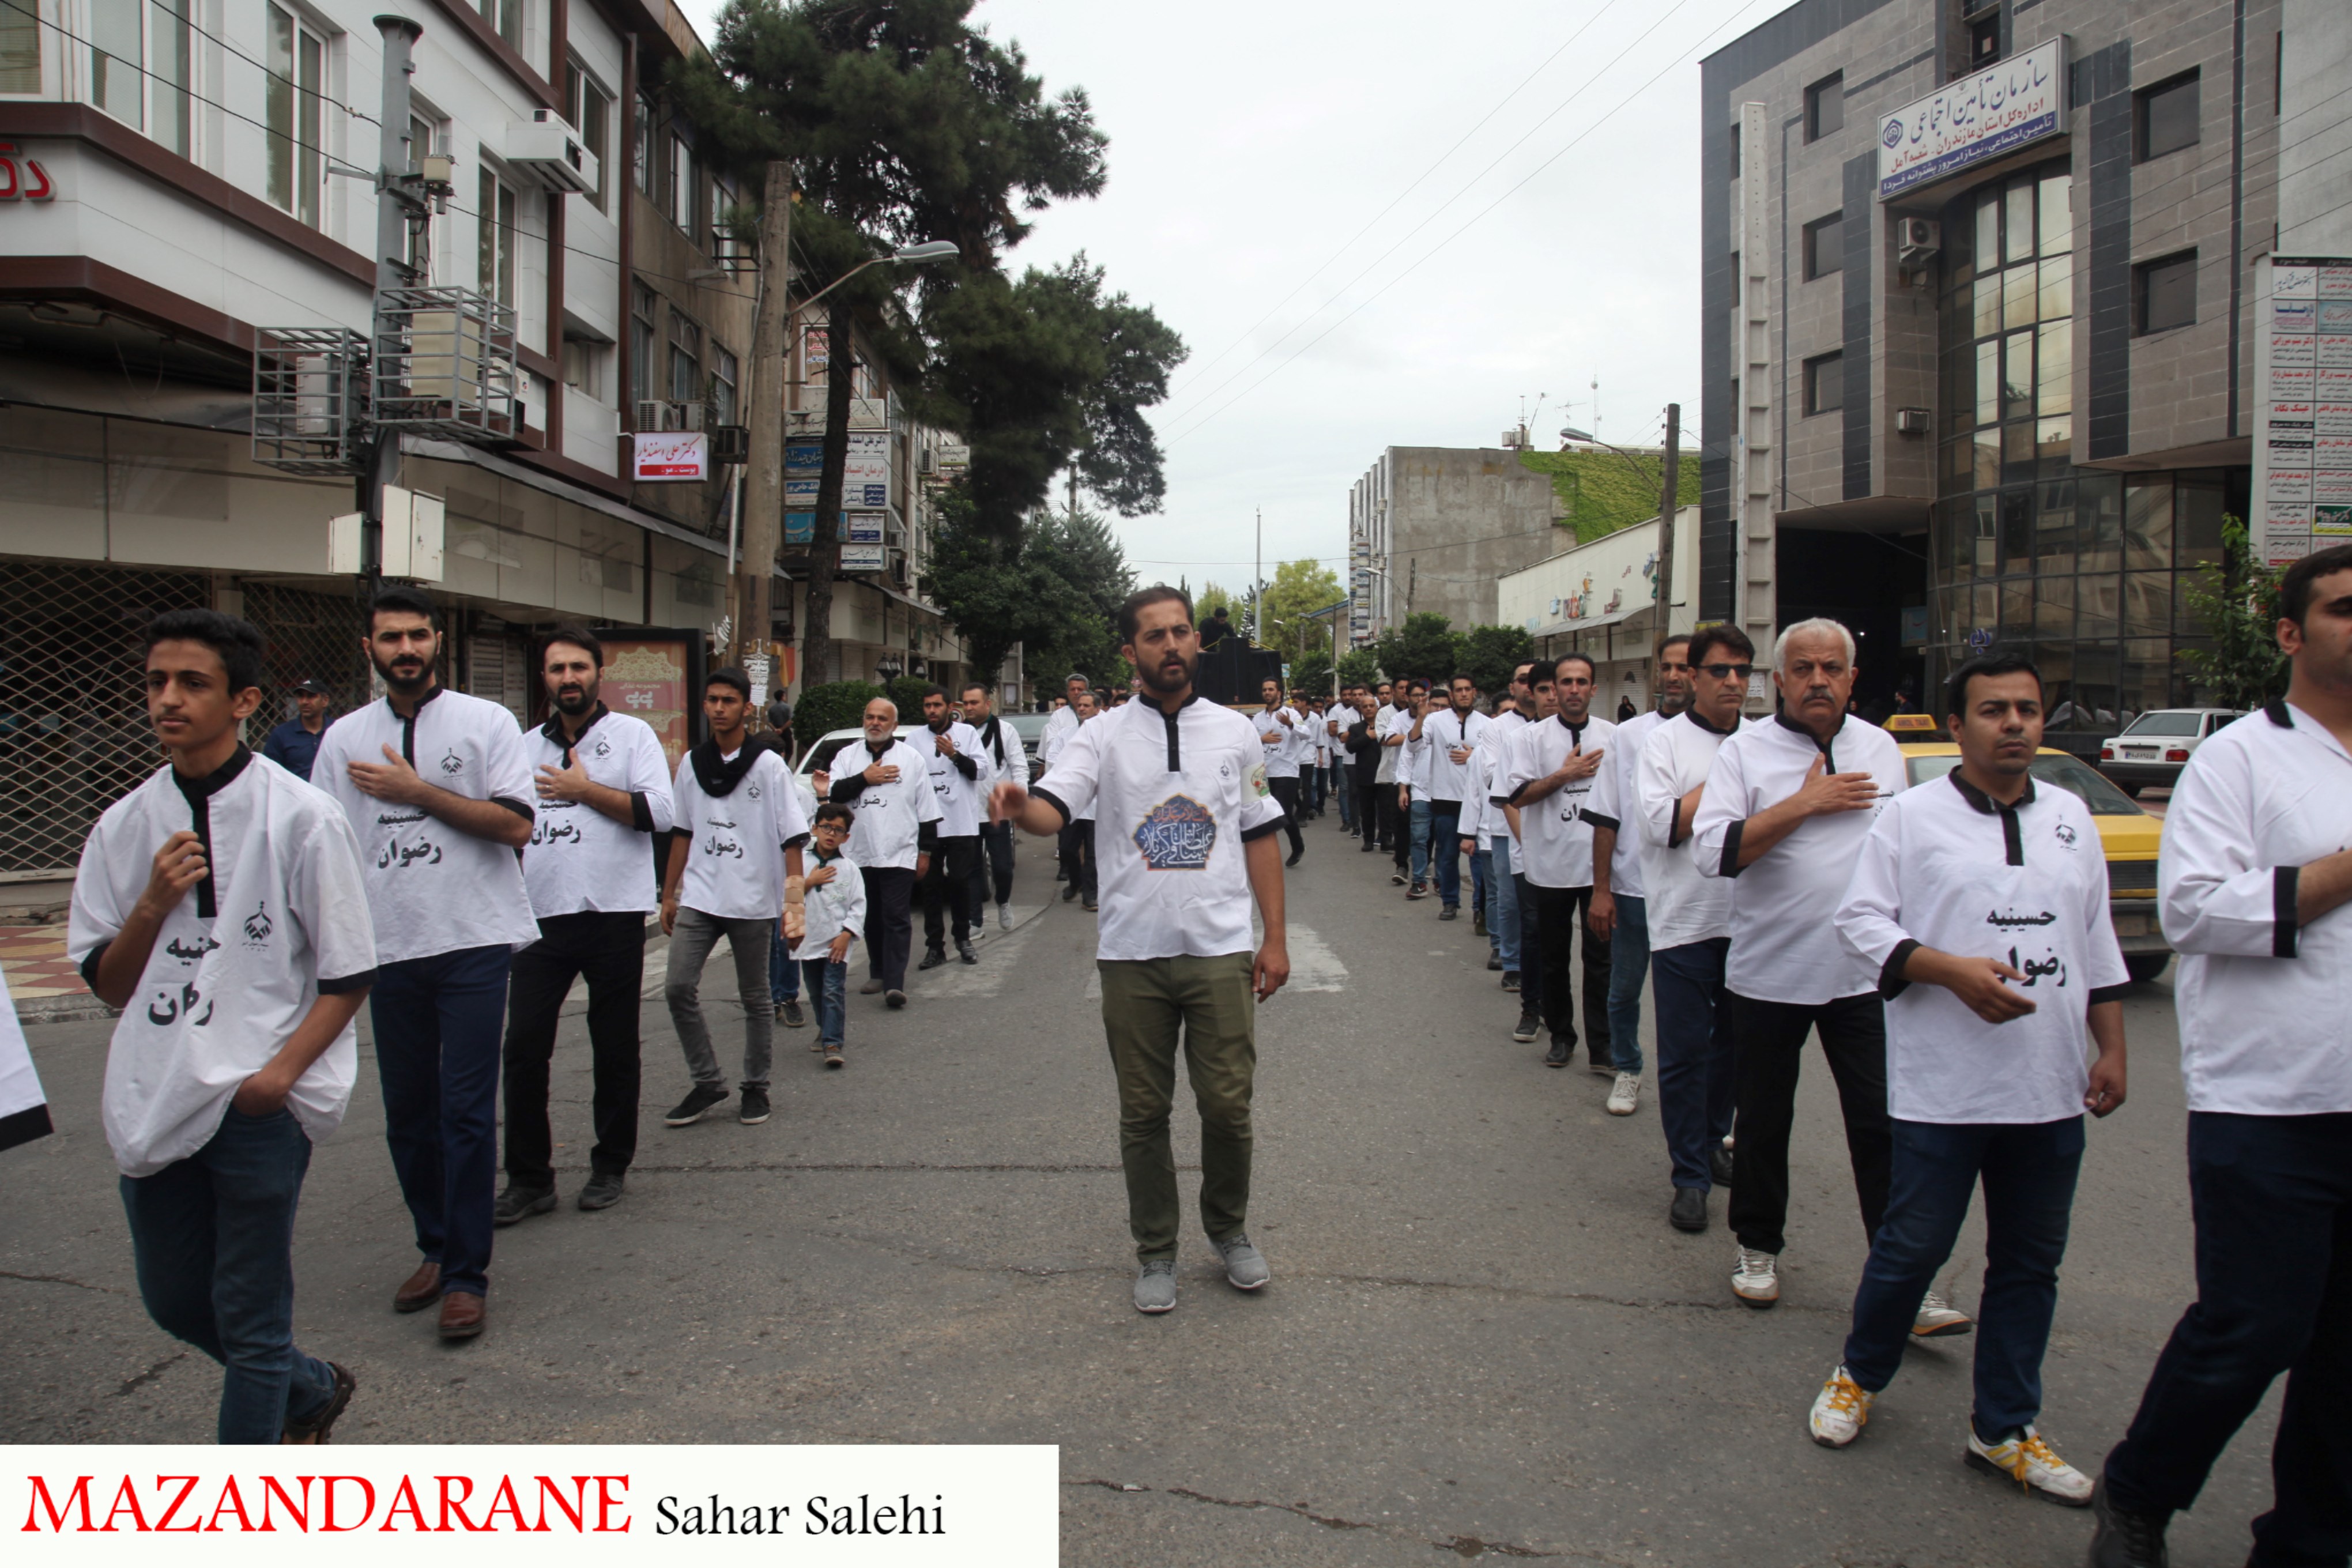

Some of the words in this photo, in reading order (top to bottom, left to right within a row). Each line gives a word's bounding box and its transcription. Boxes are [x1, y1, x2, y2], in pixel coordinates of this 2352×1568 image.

[1991, 59, 2048, 111] سازمان
[1953, 76, 1994, 126] تأمین
[2017, 96, 2044, 120] اداره
[1910, 97, 1951, 144] اجتماعی
[1976, 114, 2003, 139] استان
[2003, 108, 2018, 127] کل
[2023, 114, 2053, 140] تأمین
[1936, 128, 1976, 154] مازندران
[1891, 149, 1909, 173] آمل
[1909, 144, 1928, 165] شعبه
[1938, 152, 1964, 172] امروز
[1963, 143, 1985, 163] نیاز
[1907, 162, 1938, 181] پشتوانه
[1883, 174, 1906, 191] فردا
[2290, 404, 2309, 414] عینک
[678, 435, 701, 461] دکتر
[865, 435, 874, 446] علی
[875, 436, 885, 447] دکتر
[637, 442, 664, 462] اسفندیار
[666, 444, 680, 462] علی
[679, 466, 696, 475] پوست
[845, 463, 864, 476] اعتیاد
[865, 463, 884, 477] درمان
[531, 819, 581, 846] رضوان
[707, 817, 737, 830] حسینیه
[378, 836, 442, 869] رضوان
[704, 835, 744, 859] رضوان
[1987, 909, 2057, 932] حسینیه
